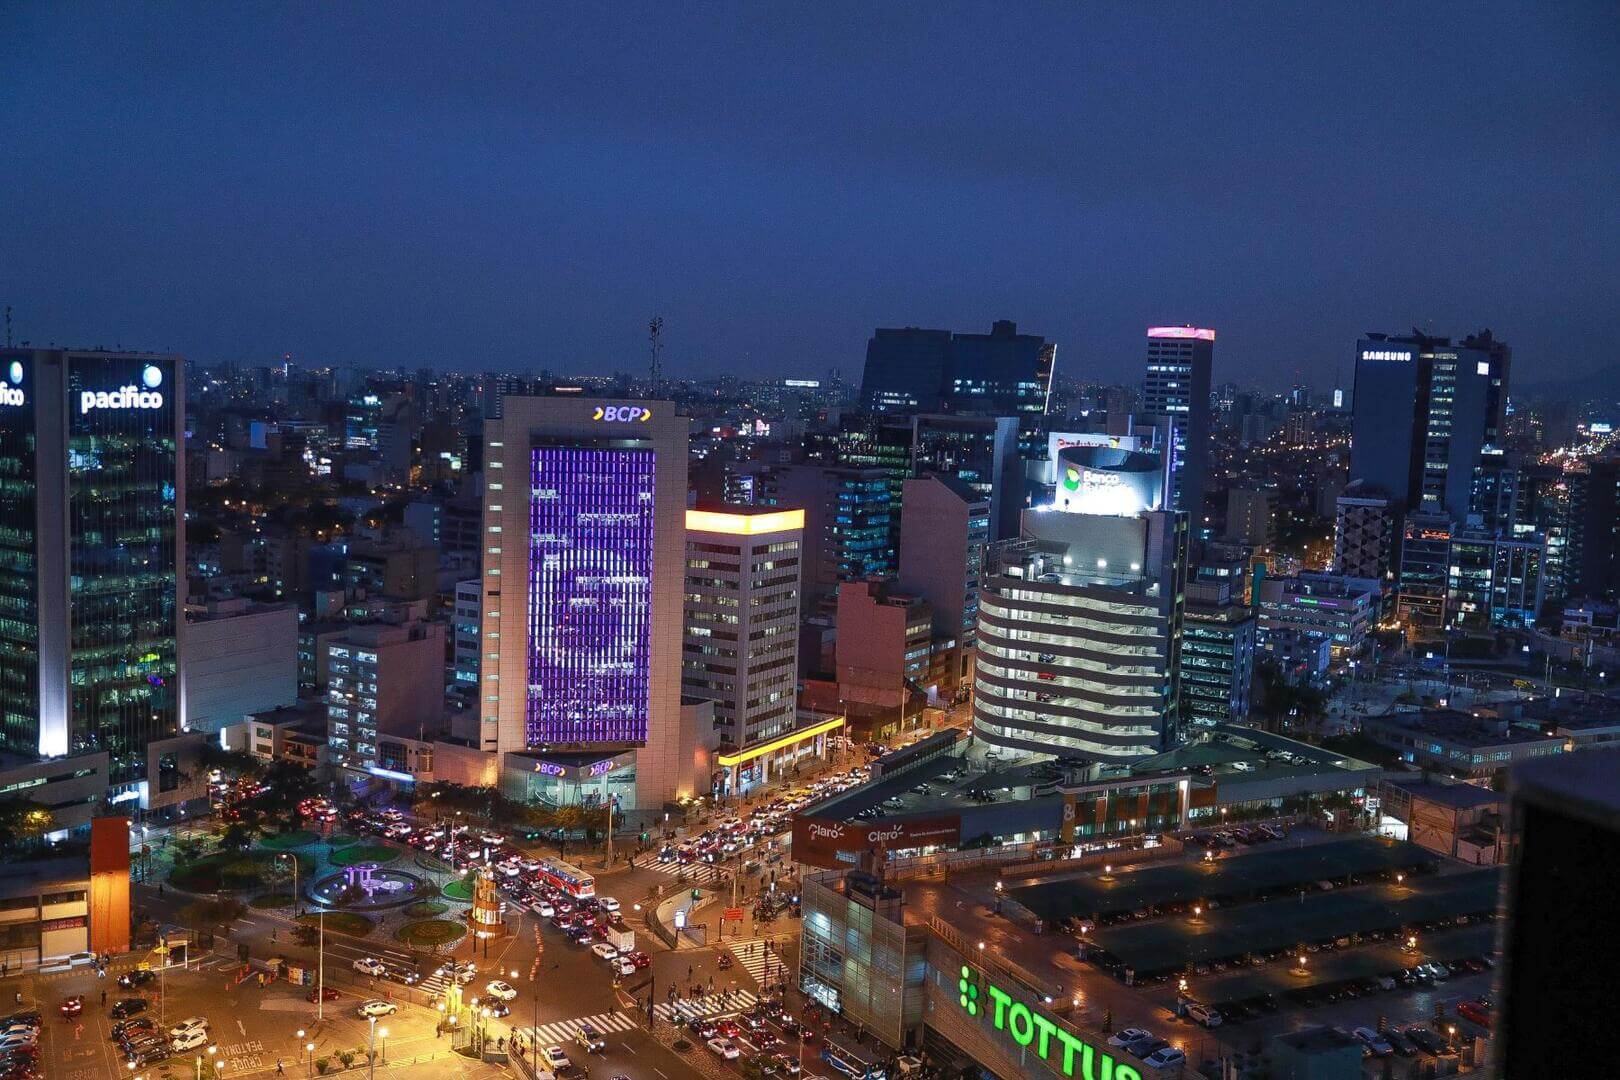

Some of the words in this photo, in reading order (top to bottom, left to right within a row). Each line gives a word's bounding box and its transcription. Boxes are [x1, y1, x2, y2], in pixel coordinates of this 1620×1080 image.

[1362, 350, 1411, 361] SAMSUNG
[81, 385, 163, 414] pacifico
[604, 406, 642, 422] BCP
[540, 763, 561, 776] BCP
[808, 823, 839, 839] Claro
[868, 829, 899, 843] Claro
[231, 1053, 263, 1071] CRUCE
